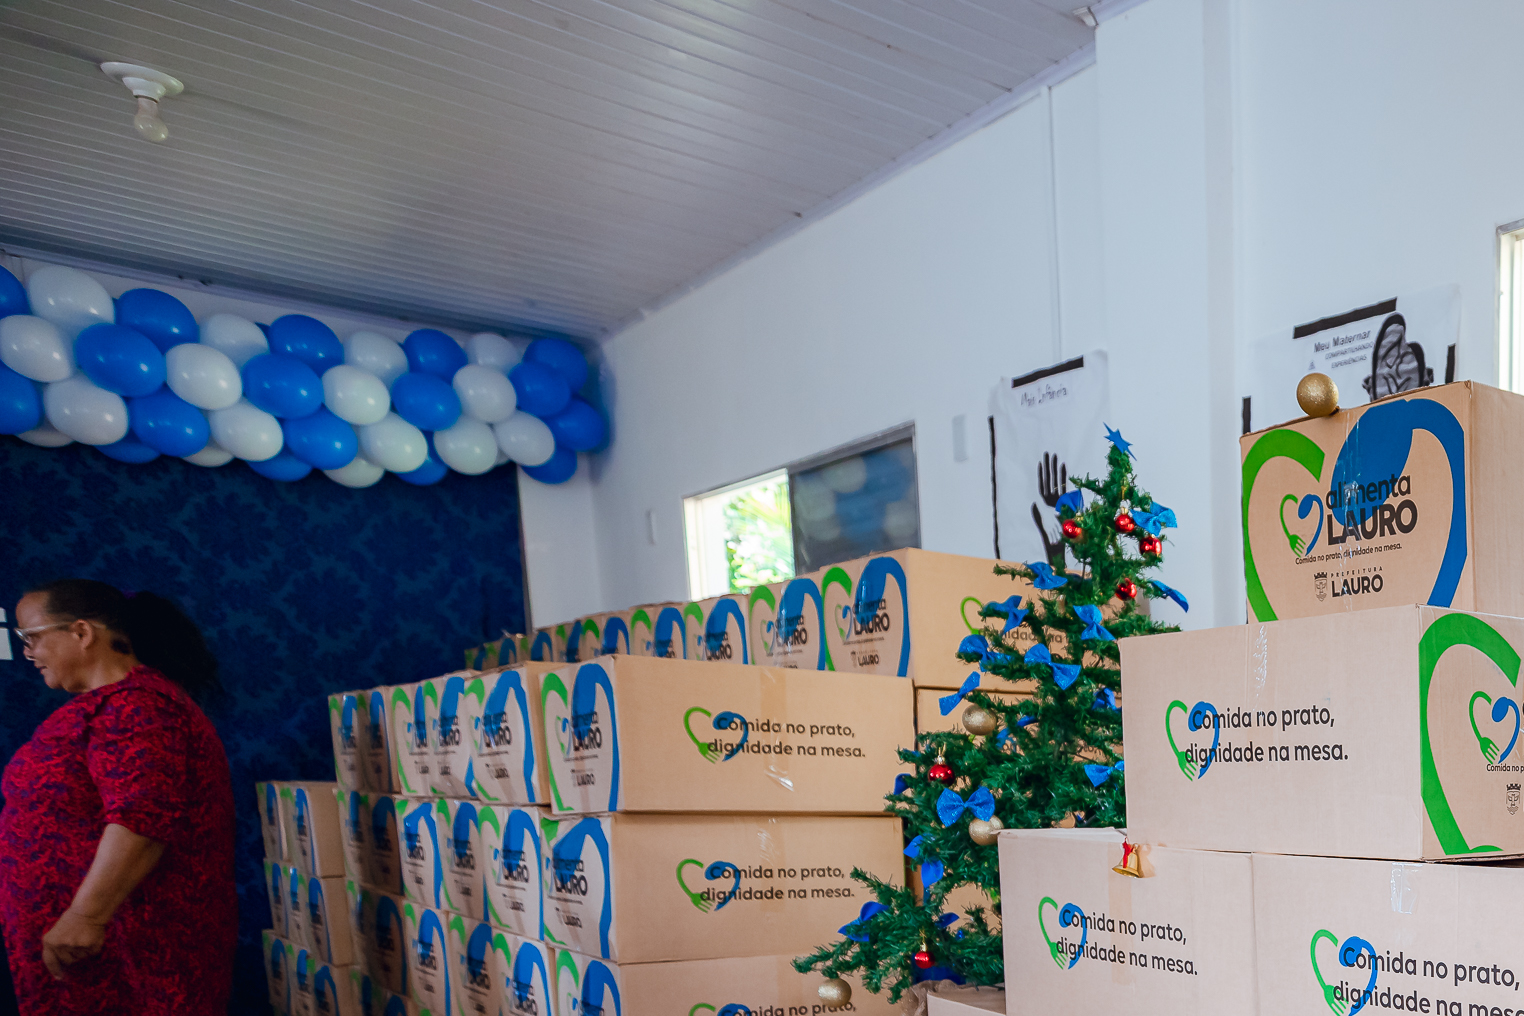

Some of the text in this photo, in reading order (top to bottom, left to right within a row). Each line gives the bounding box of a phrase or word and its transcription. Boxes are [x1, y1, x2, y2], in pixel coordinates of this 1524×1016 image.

[1326, 474, 1411, 509] alimenta
[1327, 499, 1417, 545] LAURO
[1332, 574, 1383, 597] LAURO
[717, 717, 855, 738] Comida no prato,
[1193, 705, 1334, 731] Comida no prato,
[707, 739, 865, 758] dignidade na mesa.
[1185, 741, 1348, 768] dignidade na mesa.
[1487, 764, 1510, 772] Comida
[710, 865, 844, 880] Comida no prato,
[700, 887, 854, 904] dignidade na mesa.
[1063, 909, 1186, 945] Comida no prato,
[1056, 937, 1197, 975] dignidade na mesa.
[1343, 947, 1519, 991] Comida no prato,
[1334, 981, 1430, 1013] dignidade
[789, 1005, 807, 1016] no
